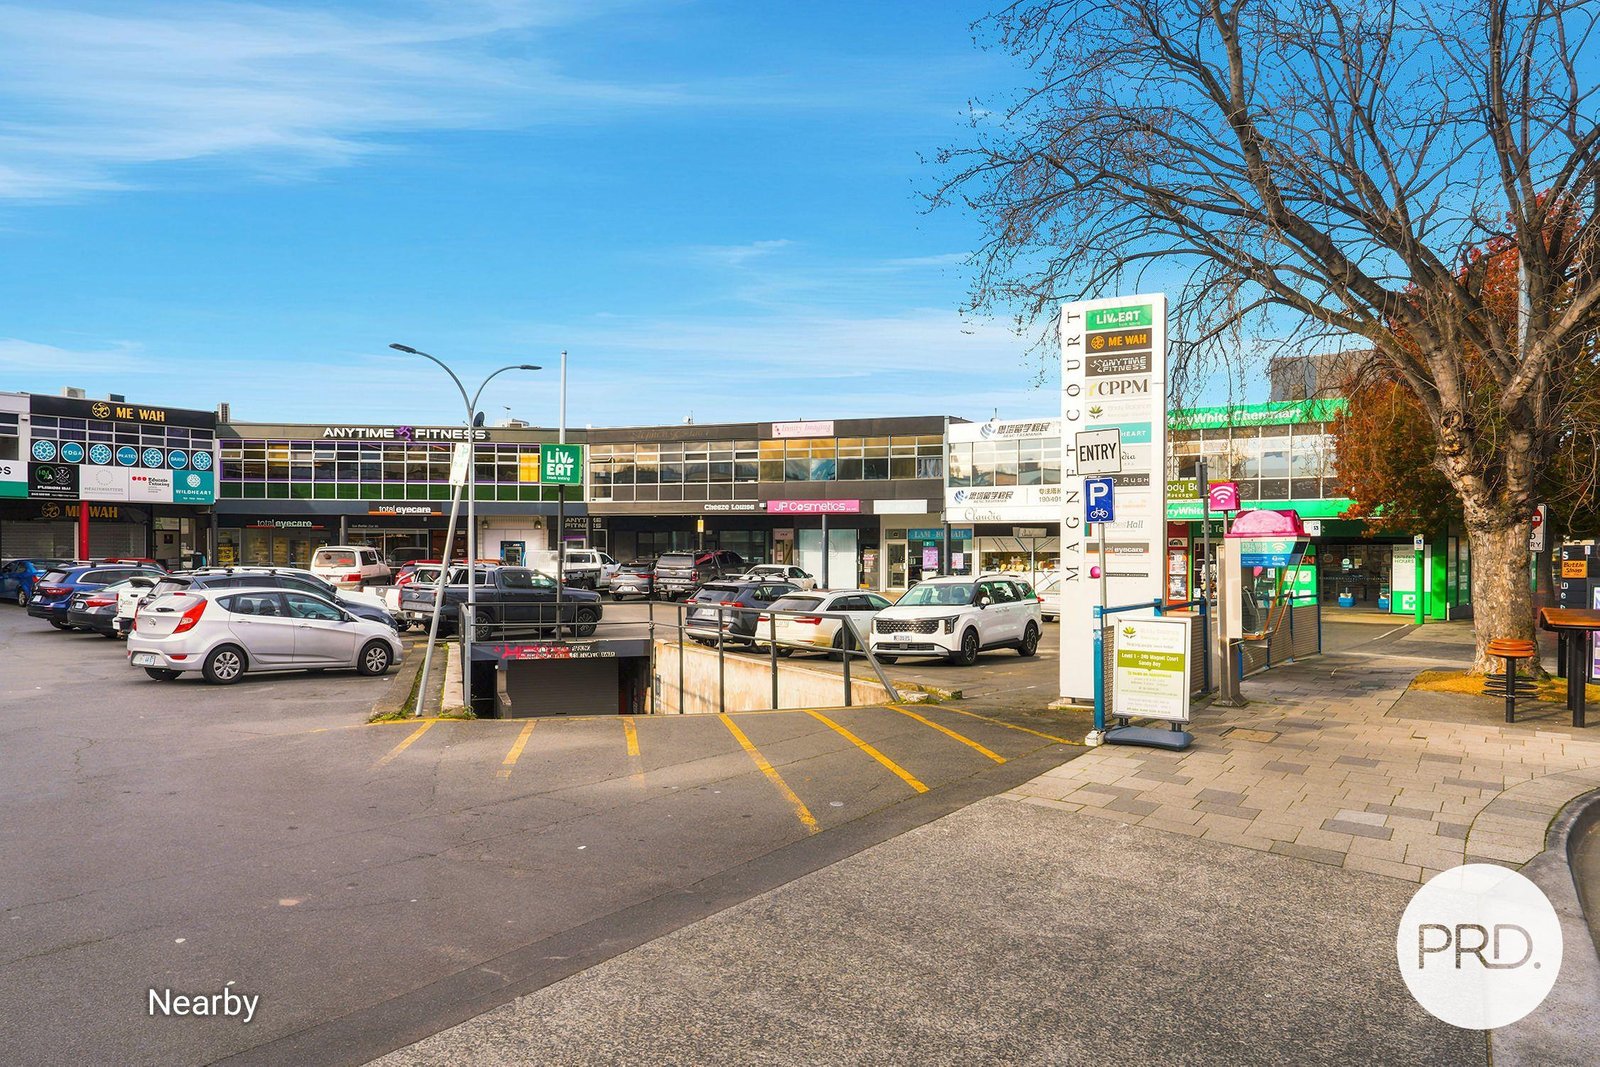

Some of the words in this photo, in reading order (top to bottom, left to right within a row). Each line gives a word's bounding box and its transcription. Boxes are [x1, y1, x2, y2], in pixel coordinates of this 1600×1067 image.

[1108, 336, 1123, 347] ME
[1125, 334, 1147, 345] WAH
[1066, 311, 1081, 422] COURT
[1102, 357, 1147, 367] ANYTIME
[1102, 364, 1147, 373] FITNESS
[1098, 379, 1148, 396] CPPM
[116, 407, 134, 420] ME
[139, 409, 166, 422] WAH
[323, 427, 395, 438] ANYTIME
[415, 428, 486, 440] FITNESS
[1079, 443, 1117, 462] ENTRY
[546, 464, 574, 476] EAT
[1090, 482, 1109, 506] P
[89, 506, 118, 518] WAH
[774, 502, 788, 511] JP
[789, 501, 846, 511] Cosmetics
[1065, 444, 1080, 582] MAGNET
